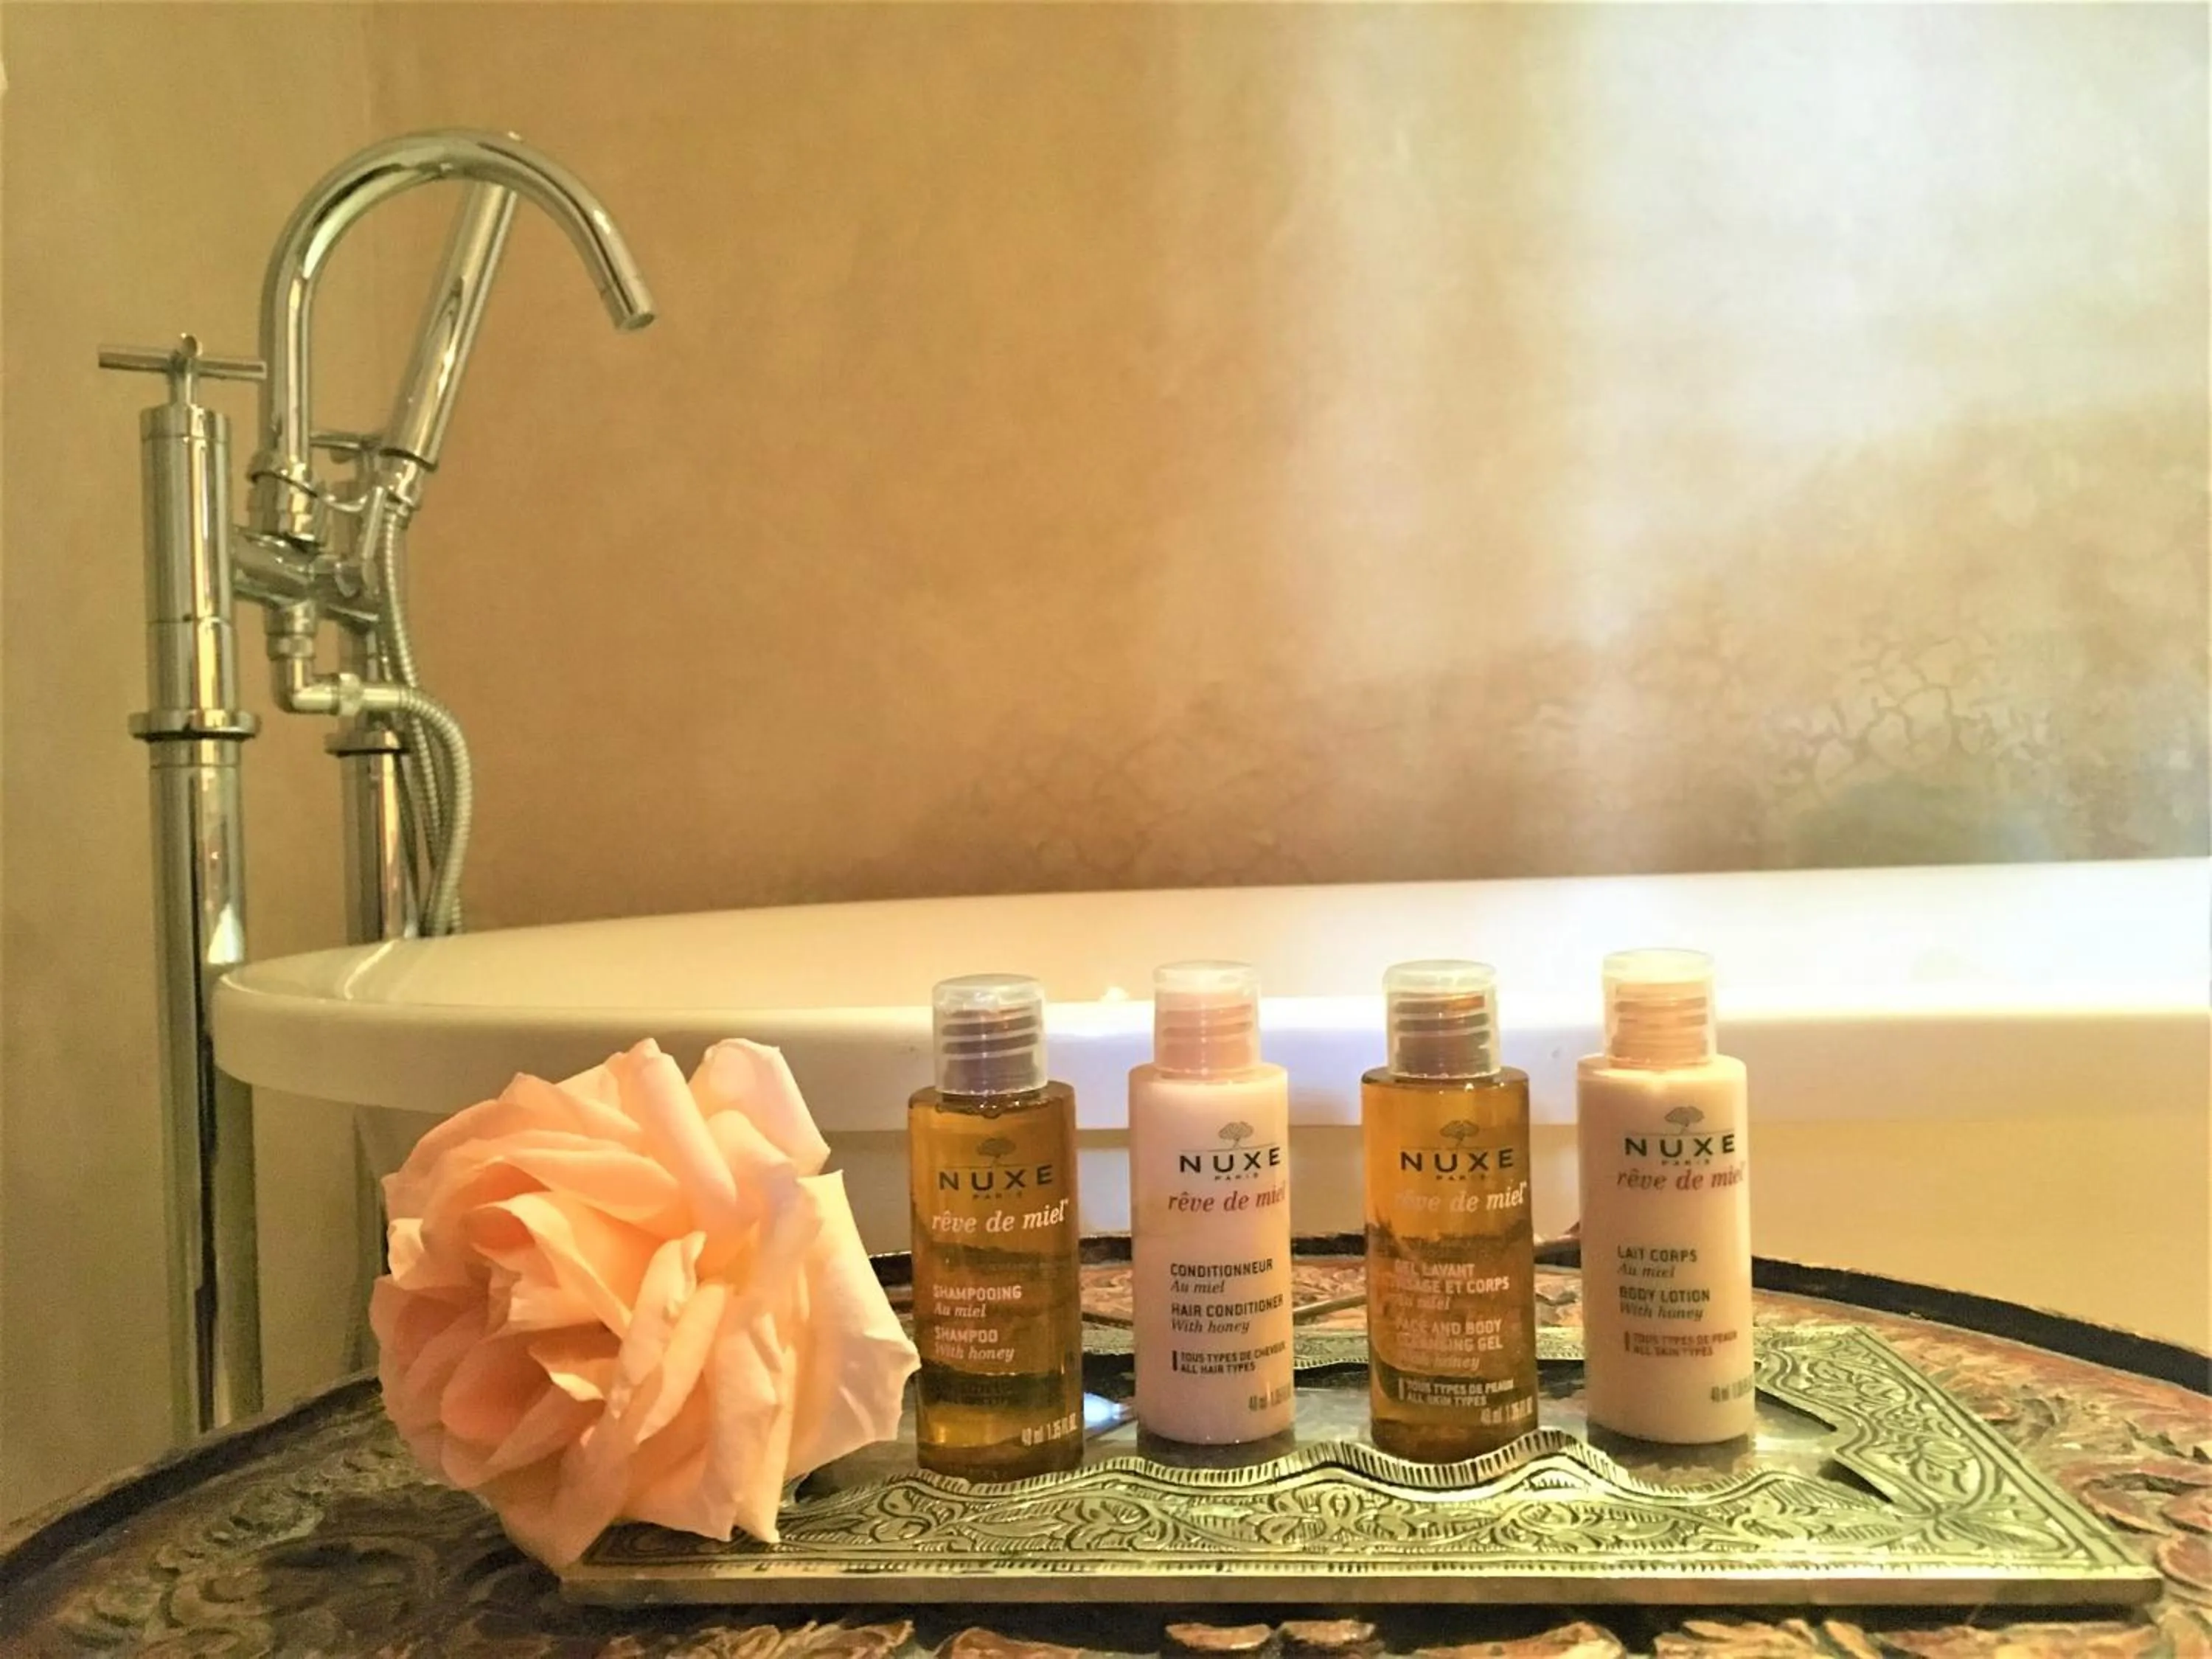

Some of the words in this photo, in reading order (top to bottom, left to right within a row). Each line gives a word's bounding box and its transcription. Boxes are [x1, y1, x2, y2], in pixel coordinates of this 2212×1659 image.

[1624, 1134, 1735, 1158] NUXE
[1180, 1147, 1280, 1173] NUXE
[1401, 1149, 1513, 1172] NUXE
[939, 1165, 1053, 1190] NUXE
[1617, 1168, 1667, 1190] rêve
[1675, 1169, 1703, 1190] de
[1168, 1191, 1215, 1212] rêve
[1223, 1190, 1250, 1211] de
[1255, 1180, 1286, 1208] miel
[1450, 1191, 1479, 1212] de
[1486, 1183, 1525, 1210] miel
[932, 1210, 977, 1233] rêve
[986, 1210, 1015, 1233] de
[1021, 1198, 1066, 1229] miel
[1617, 1245, 1644, 1260] LAIT
[1650, 1249, 1697, 1262] CORPS
[1170, 1259, 1273, 1278] CONDITIONNEUR
[1422, 1263, 1475, 1279] LAVANT
[1617, 1263, 1637, 1276] Au
[1642, 1265, 1676, 1278] miel
[933, 1284, 1022, 1301] SHAMPOOING
[1170, 1280, 1189, 1293] Au
[1194, 1279, 1225, 1293] miel
[1445, 1280, 1462, 1295] ET
[1467, 1276, 1510, 1293] CORPS
[1619, 1285, 1655, 1301] BODY
[1660, 1289, 1710, 1303] LOTION
[934, 1301, 950, 1316] Au
[955, 1304, 987, 1318] miel
[1171, 1303, 1202, 1317] HAIR
[1206, 1293, 1284, 1318] CONDITIONER
[1620, 1303, 1652, 1318] With
[1658, 1307, 1703, 1321] honey
[934, 1325, 998, 1343] SHAMPOO
[1171, 1318, 1203, 1333] With
[1208, 1320, 1251, 1334] honey
[1433, 1321, 1461, 1337] AND
[1466, 1318, 1502, 1335] BODY
[935, 1342, 964, 1360] With
[968, 1346, 1015, 1363] honey
[1478, 1335, 1504, 1352] GEL
[1180, 1351, 1204, 1362] TOUS
[1207, 1351, 1237, 1363] TYPES
[1239, 1350, 1251, 1361] DE
[1180, 1364, 1197, 1374] ALL
[1200, 1363, 1223, 1374] HAIR
[1227, 1363, 1256, 1373] TYPES
[1433, 1383, 1466, 1394] TYPES
[1469, 1383, 1483, 1394] DE
[1407, 1392, 1425, 1404] ALL
[1454, 1395, 1487, 1408] TYPES
